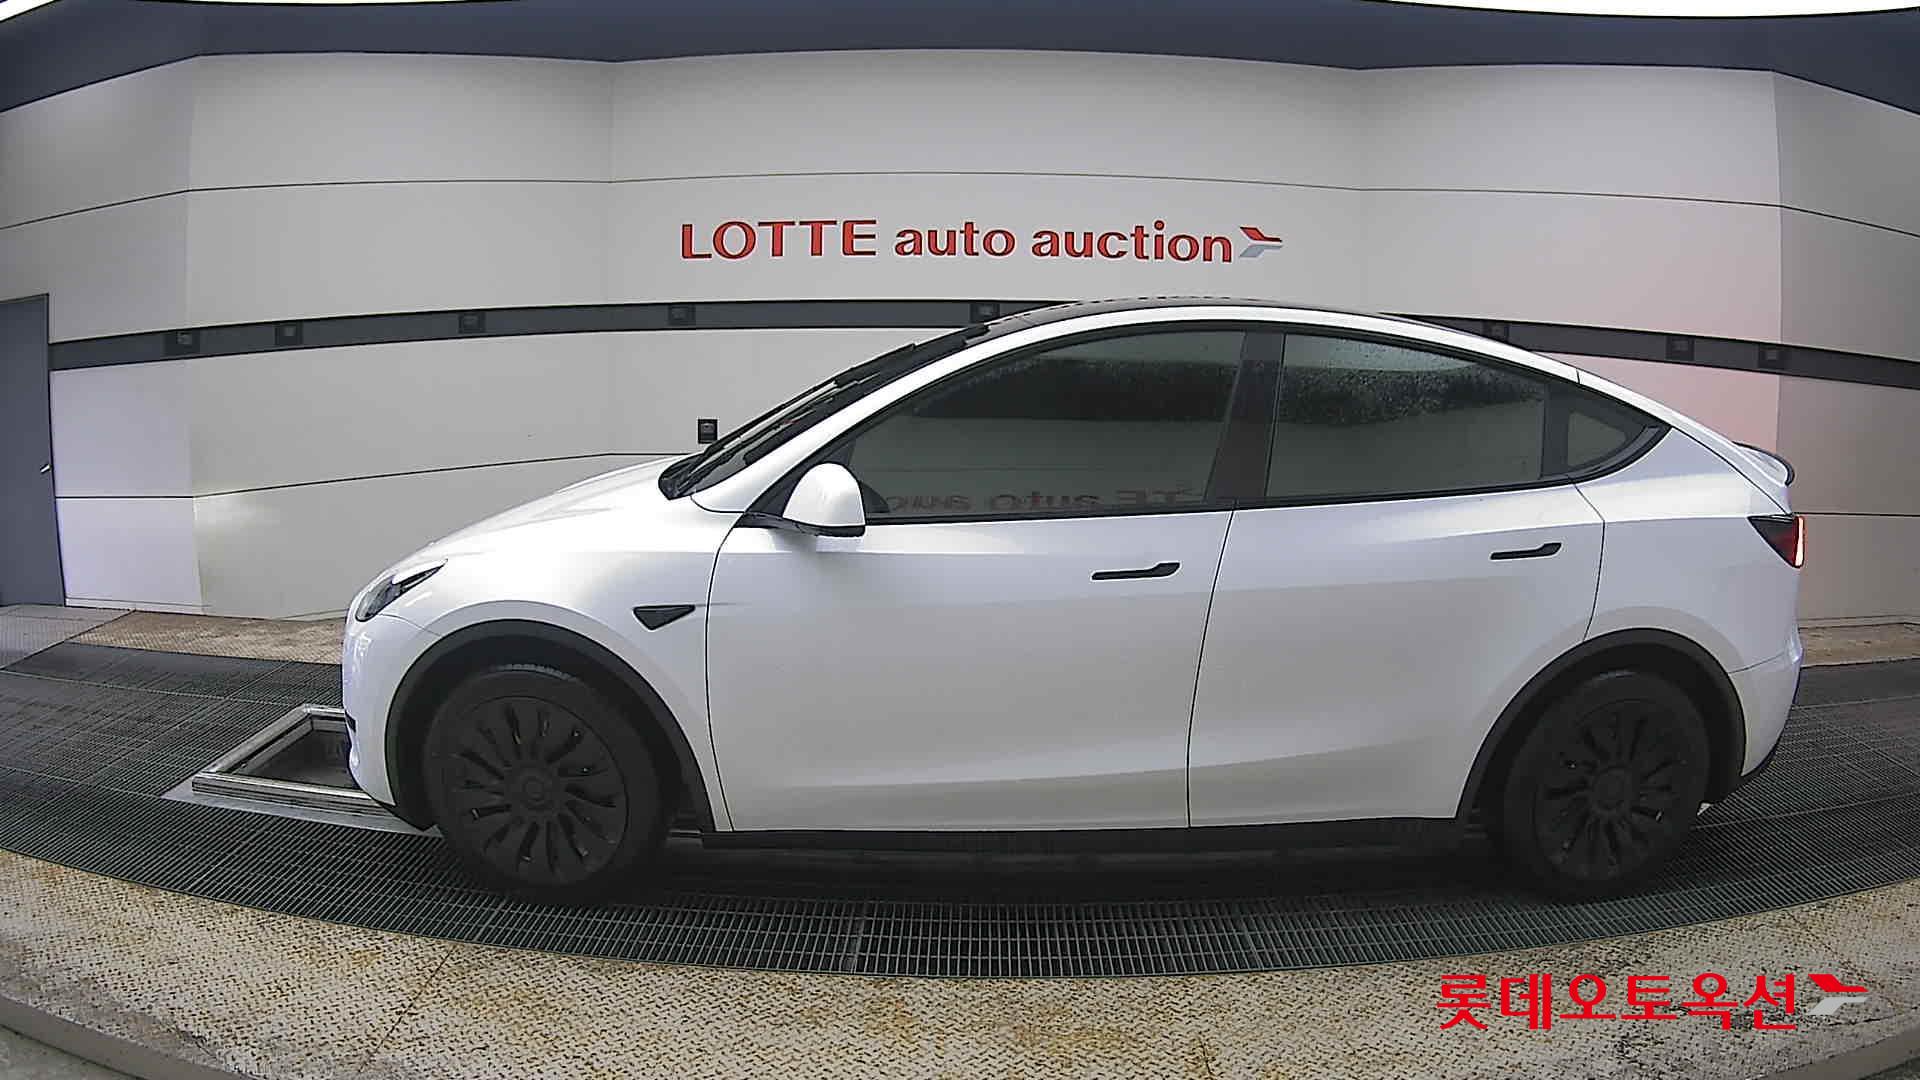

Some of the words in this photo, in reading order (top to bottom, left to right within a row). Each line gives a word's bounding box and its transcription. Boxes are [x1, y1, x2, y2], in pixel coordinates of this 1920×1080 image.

[681, 219, 877, 260] LOTTE
[895, 221, 1016, 257] auto
[1031, 220, 1232, 263] auction
